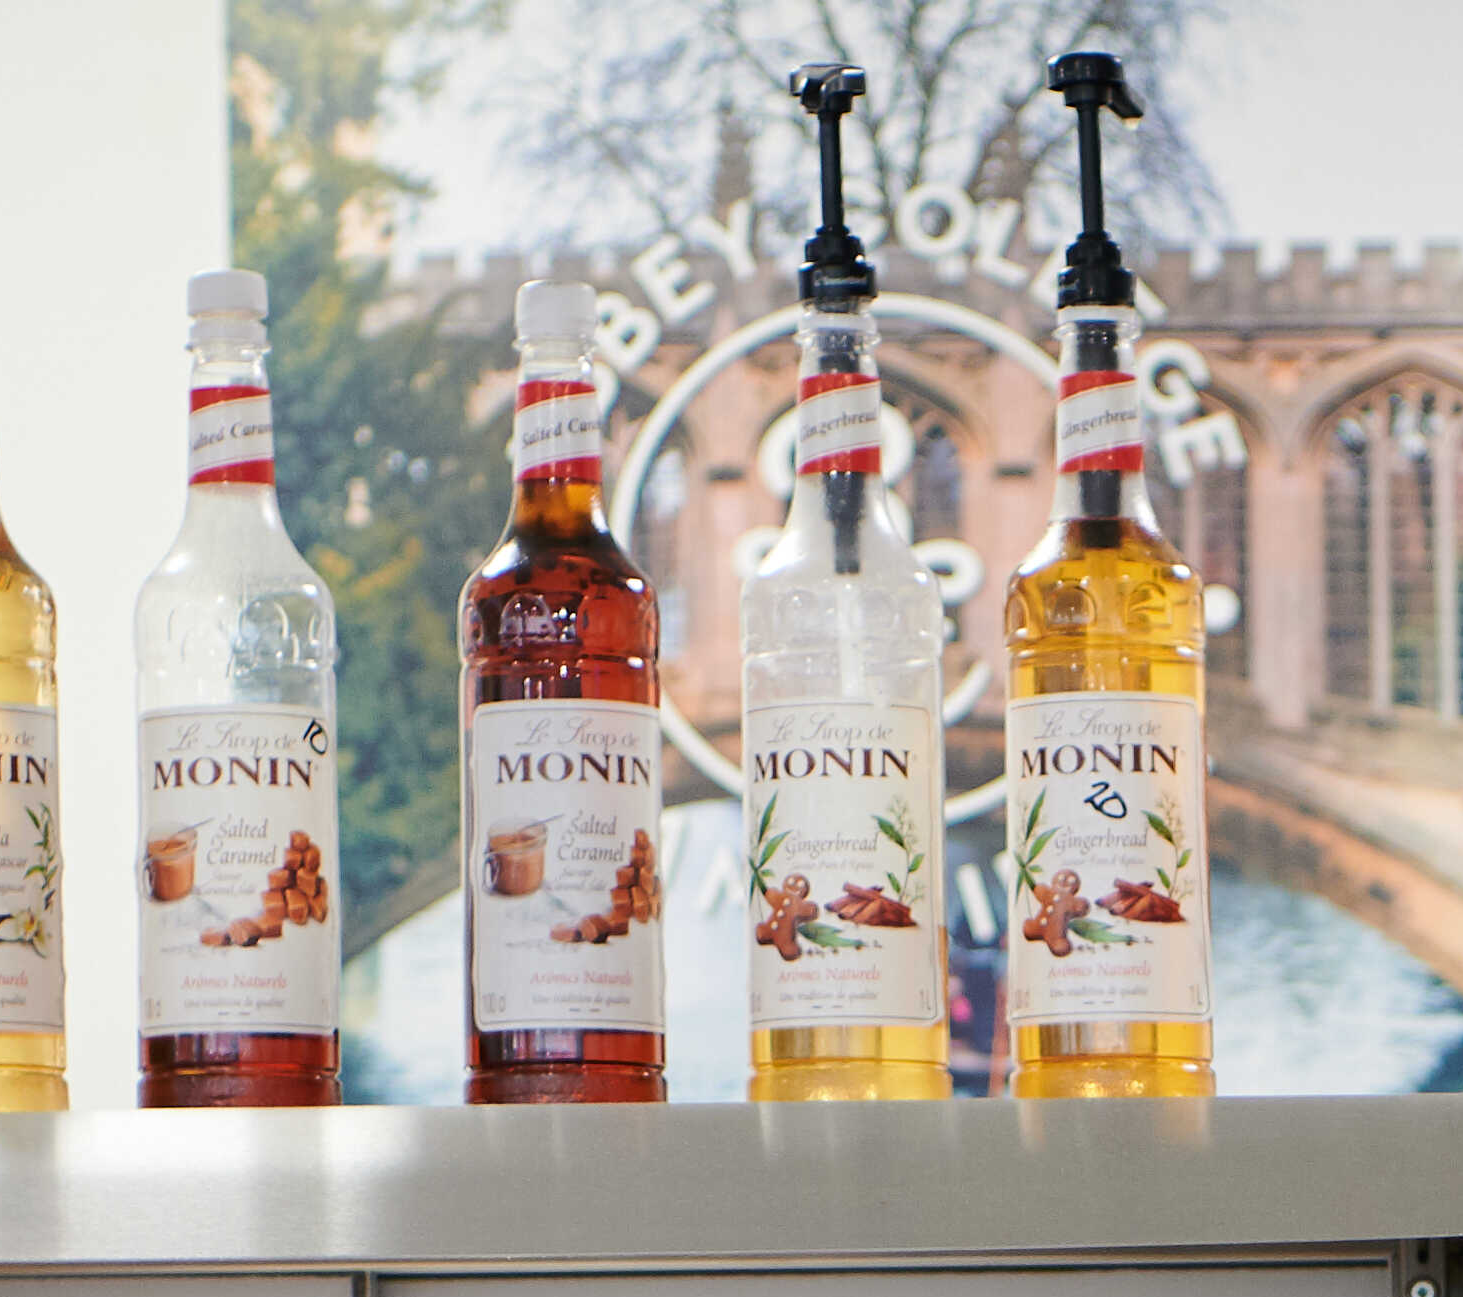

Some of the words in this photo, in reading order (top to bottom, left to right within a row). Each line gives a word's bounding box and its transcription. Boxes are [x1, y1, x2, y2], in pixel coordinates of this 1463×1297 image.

[153, 756, 314, 791] MONIN
[497, 752, 650, 786] MONIN
[754, 748, 911, 783] MONIN
[1021, 744, 1178, 779] MONIN
[216, 815, 268, 840] Salted
[567, 811, 617, 836] Salted
[206, 837, 278, 866] Caramel
[556, 836, 625, 863] Caramel
[785, 836, 879, 859] Gingerbread
[1054, 831, 1148, 855] Gingerbread
